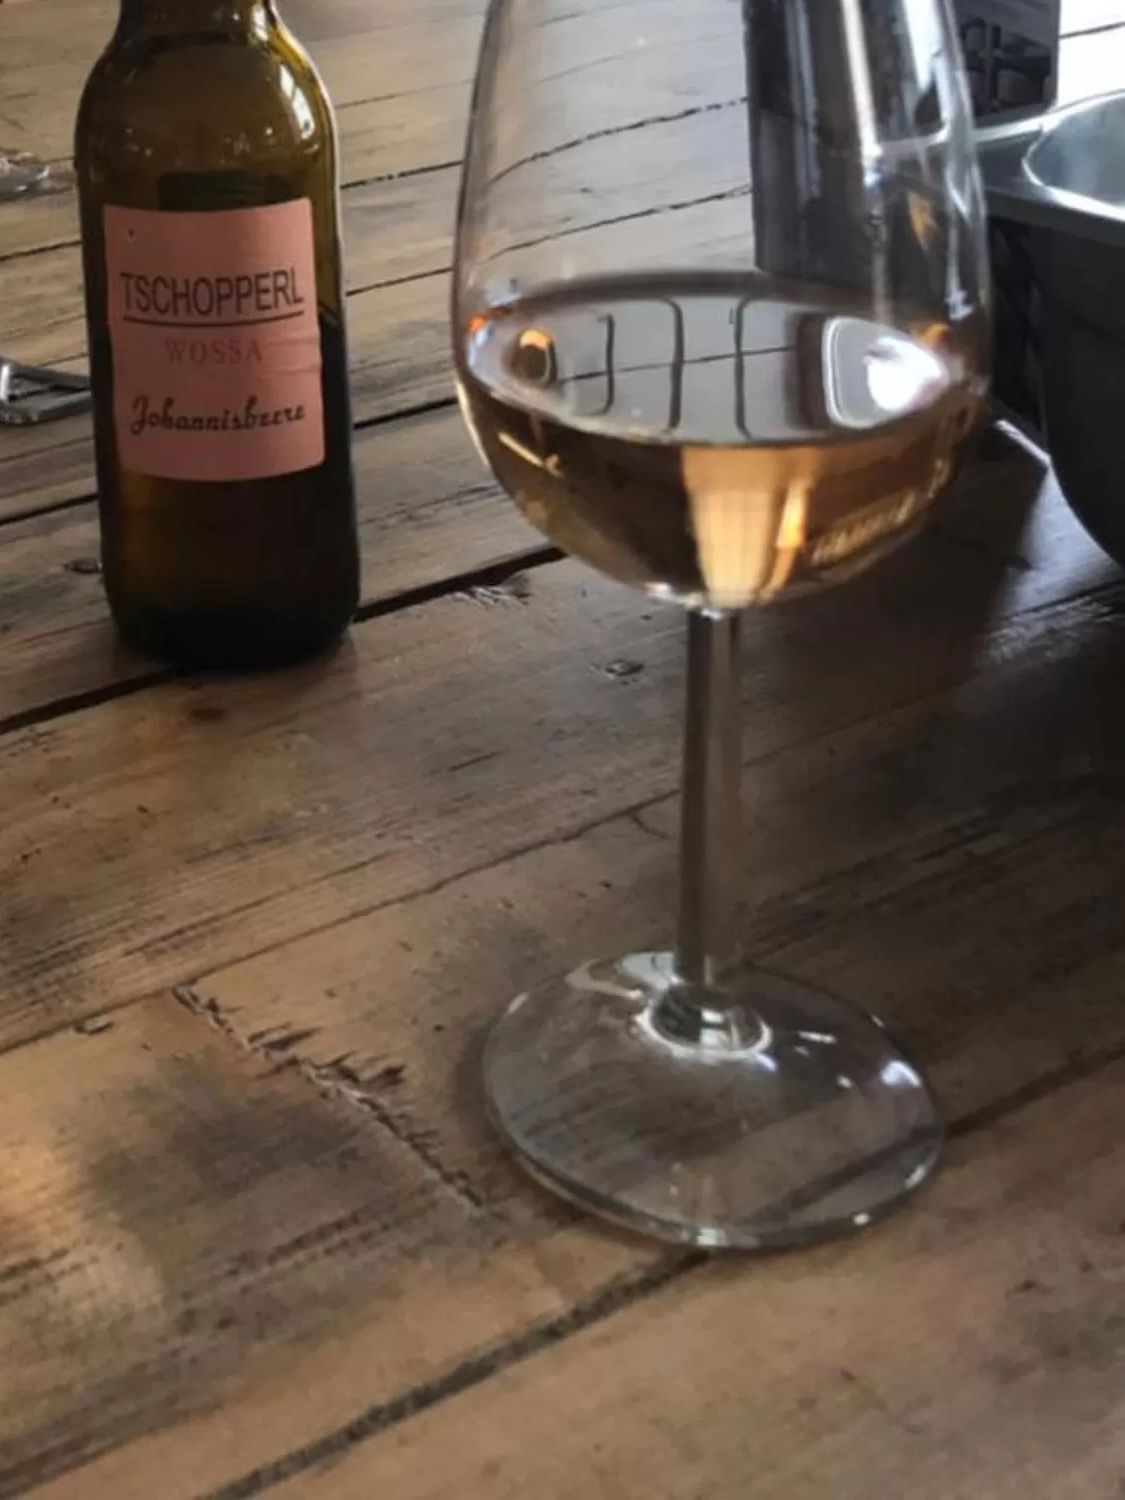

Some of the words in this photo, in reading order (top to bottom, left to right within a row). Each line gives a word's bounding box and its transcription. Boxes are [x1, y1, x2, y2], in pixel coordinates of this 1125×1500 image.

[120, 266, 305, 318] TSCHOPPERL
[167, 338, 263, 365] WOSSA
[130, 395, 306, 437] Johannisbeere
